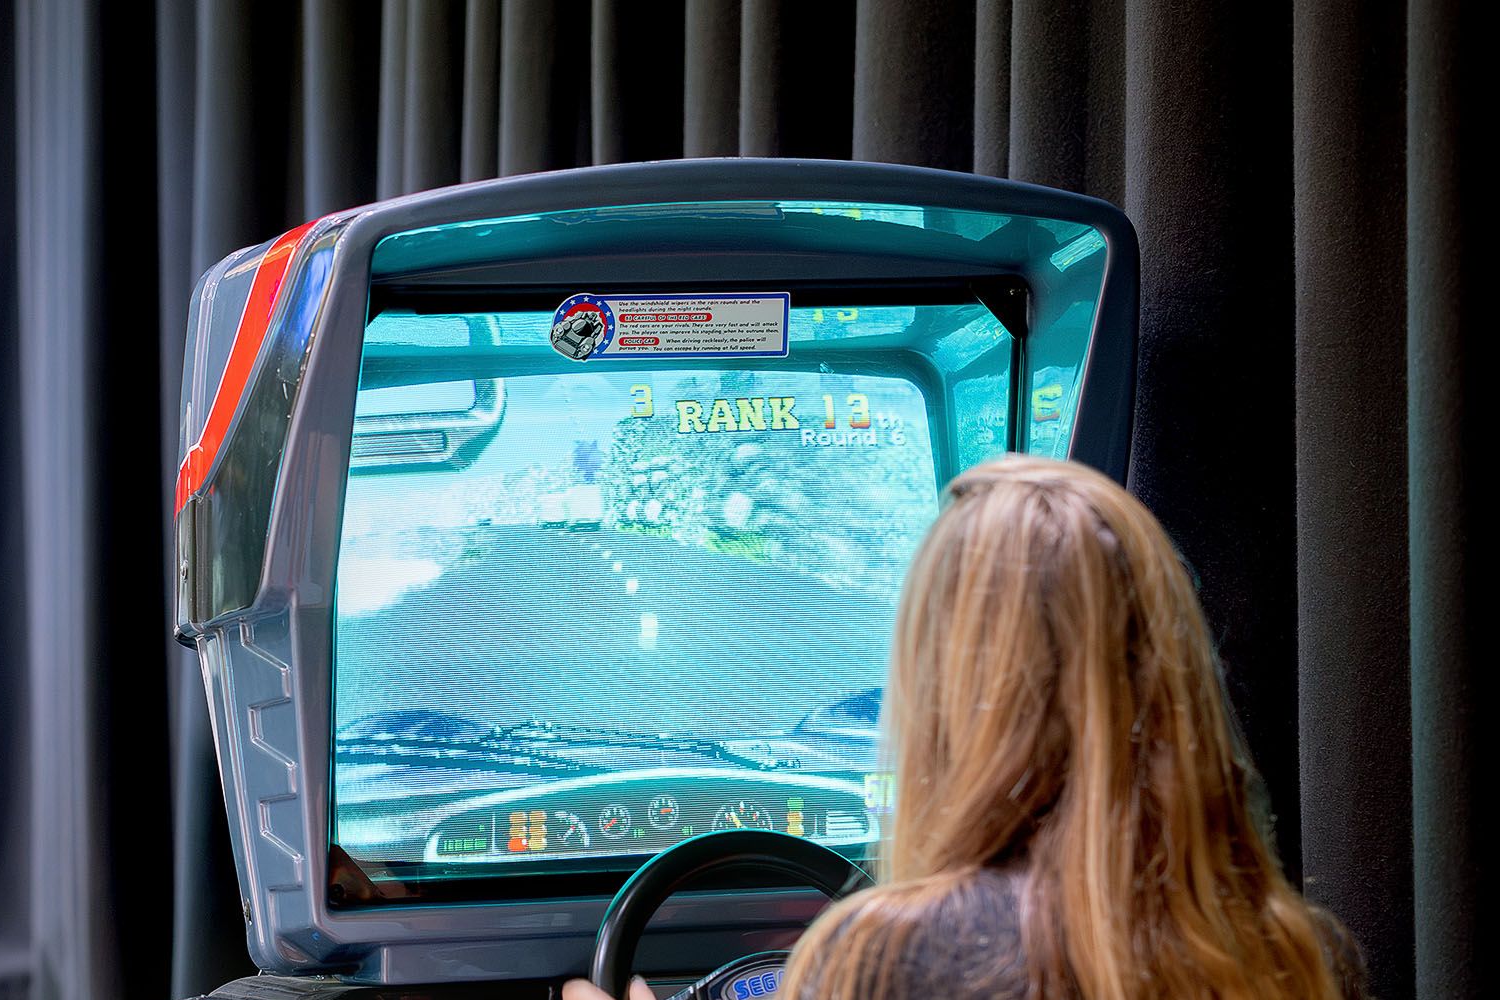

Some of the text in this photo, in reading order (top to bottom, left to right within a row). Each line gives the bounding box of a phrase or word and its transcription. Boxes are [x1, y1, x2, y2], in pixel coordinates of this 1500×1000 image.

[676, 396, 799, 433] RANK
[802, 428, 906, 446] Round 6
